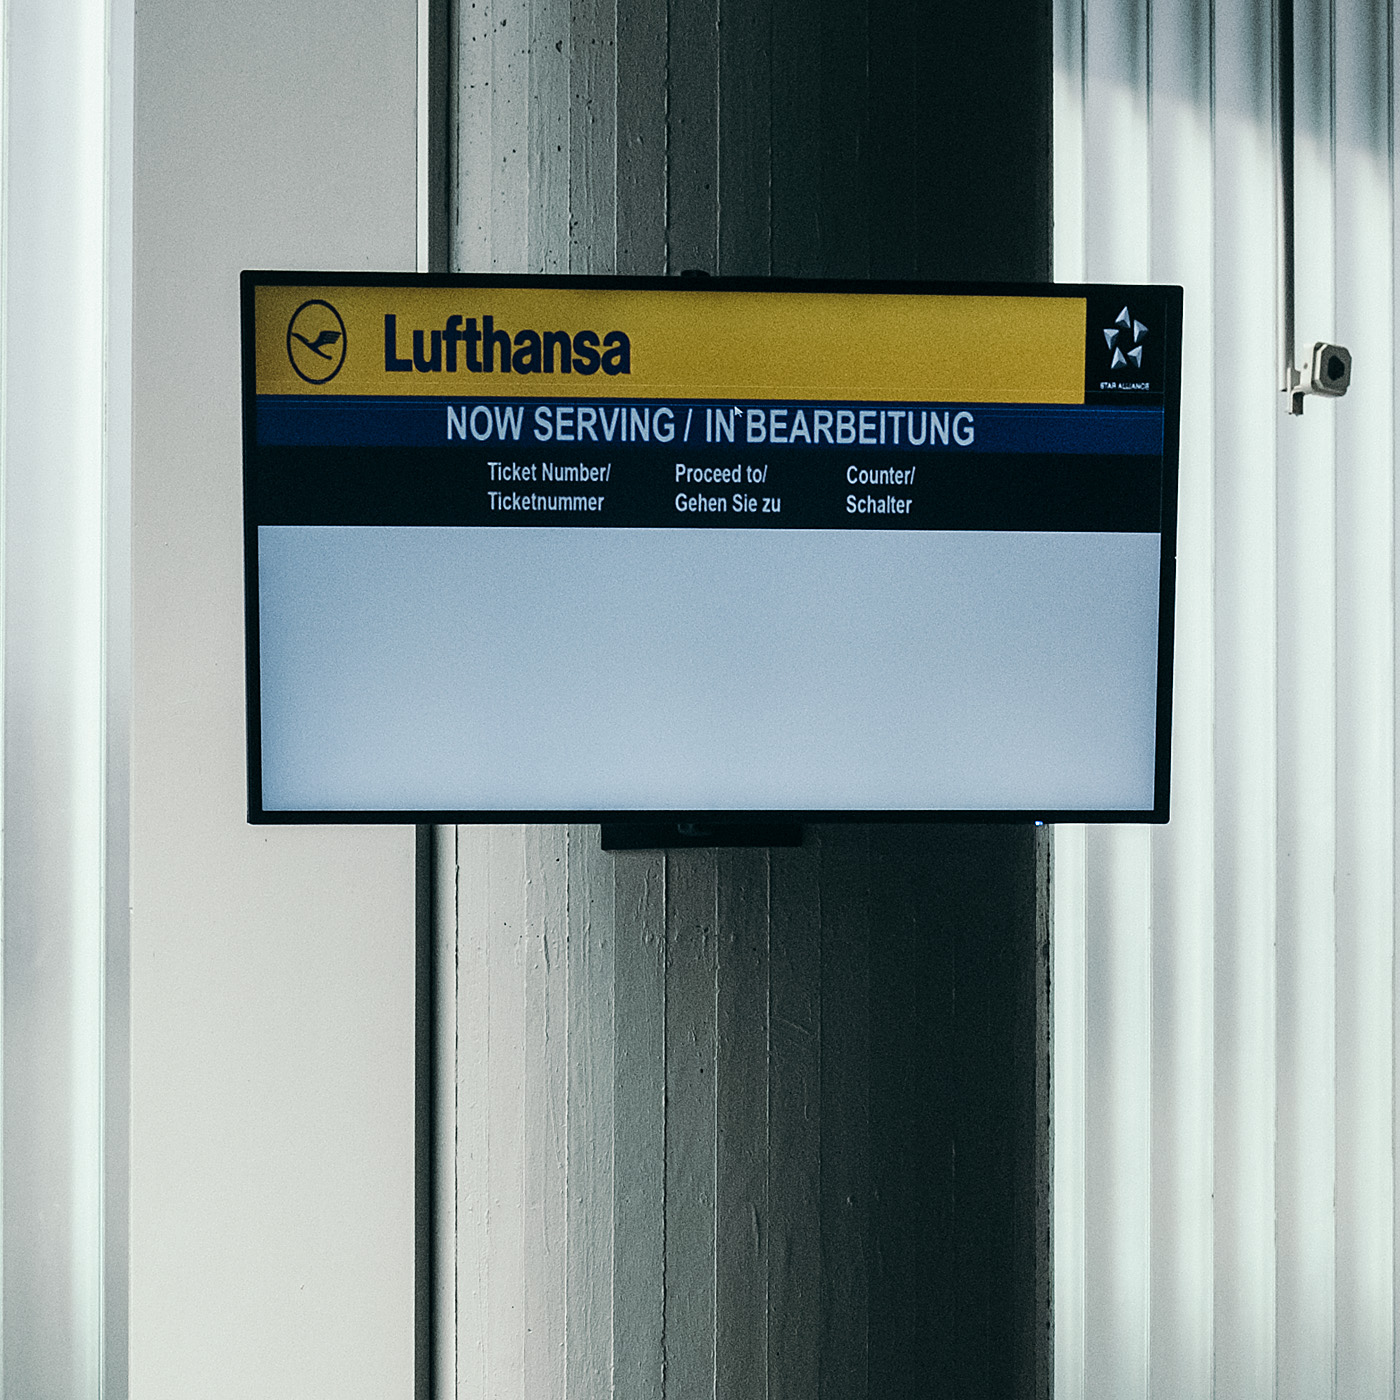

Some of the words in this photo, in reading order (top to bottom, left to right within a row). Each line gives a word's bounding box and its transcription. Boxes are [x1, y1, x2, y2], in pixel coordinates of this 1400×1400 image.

[384, 313, 631, 377] Lufthansa
[1099, 381, 1117, 390] STAR
[1118, 382, 1150, 391] ALLIANCE
[447, 405, 525, 441] NOW
[533, 406, 675, 442] SERVING
[684, 408, 693, 442] /
[706, 408, 734, 443] IN
[746, 409, 975, 446] BEARBEITUNG
[487, 461, 537, 482] Ticket
[542, 462, 612, 482] Number/
[674, 463, 742, 483] Proceed
[746, 463, 769, 484] to/
[846, 465, 916, 485] Counter/
[487, 491, 605, 511] Ticketnummer
[674, 493, 728, 512] Gehen
[732, 493, 758, 513] Sie
[762, 498, 781, 513] zu
[846, 494, 913, 514] Schalter
